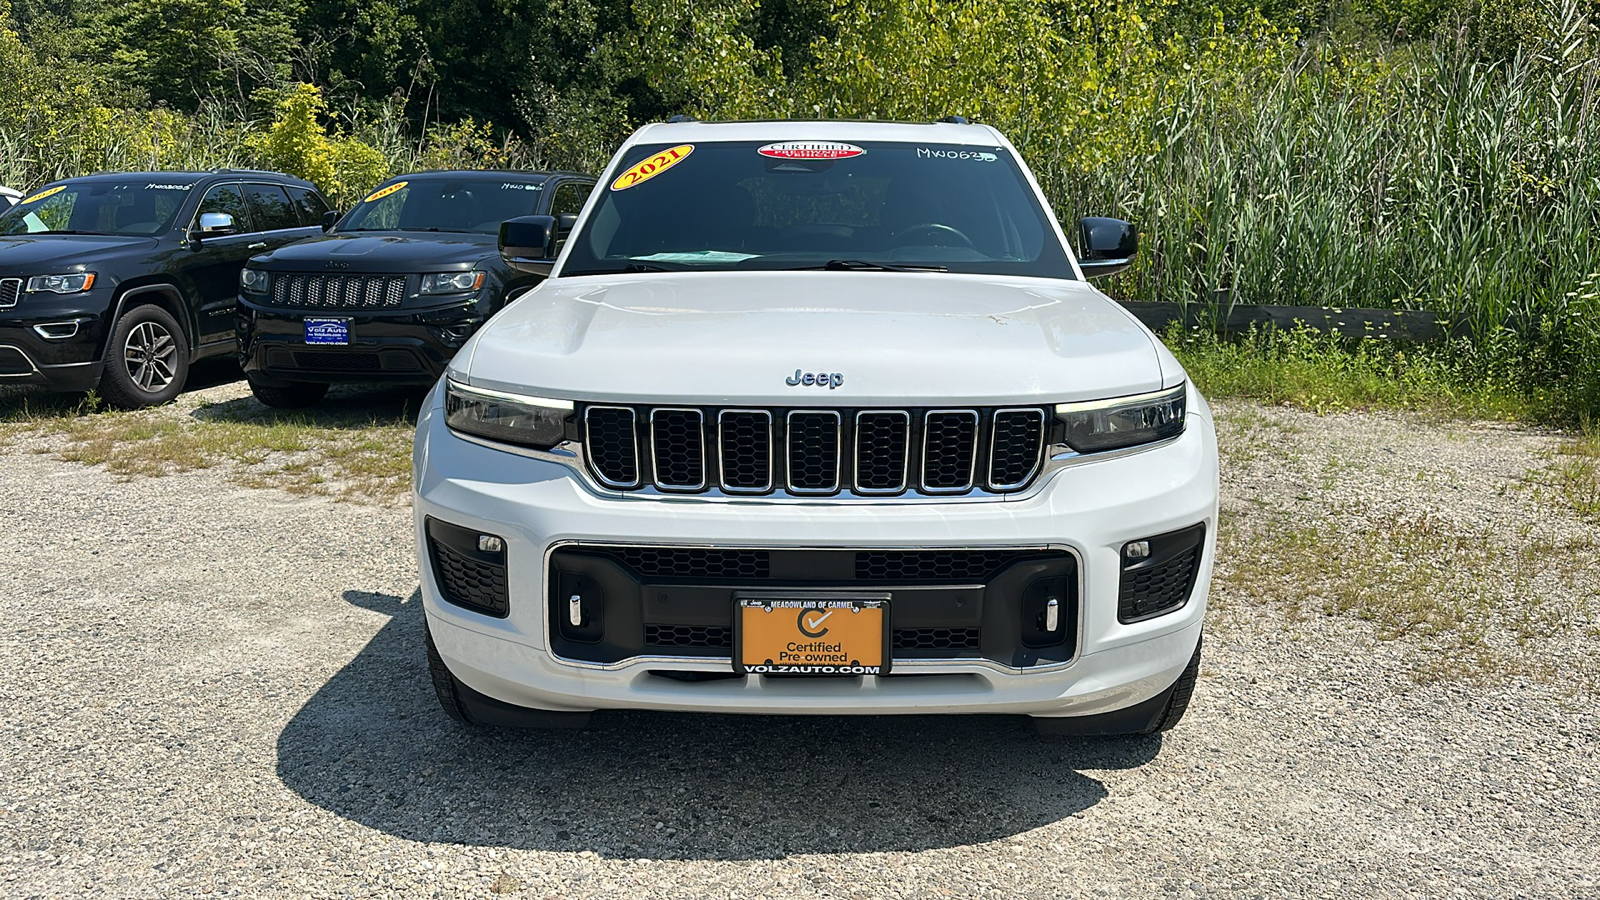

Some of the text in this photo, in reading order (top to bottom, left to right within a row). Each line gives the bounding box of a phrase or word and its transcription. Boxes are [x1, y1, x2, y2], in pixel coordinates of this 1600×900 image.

[624, 150, 686, 184] 2021
[785, 369, 844, 390] Jeep
[770, 601, 817, 609] MEADOWLAND
[818, 601, 826, 609] OF
[827, 601, 854, 609] CARMEL
[786, 642, 842, 653] Certified
[779, 652, 848, 663] Pre-owned
[744, 666, 880, 674] VOLZAUTO.COM
